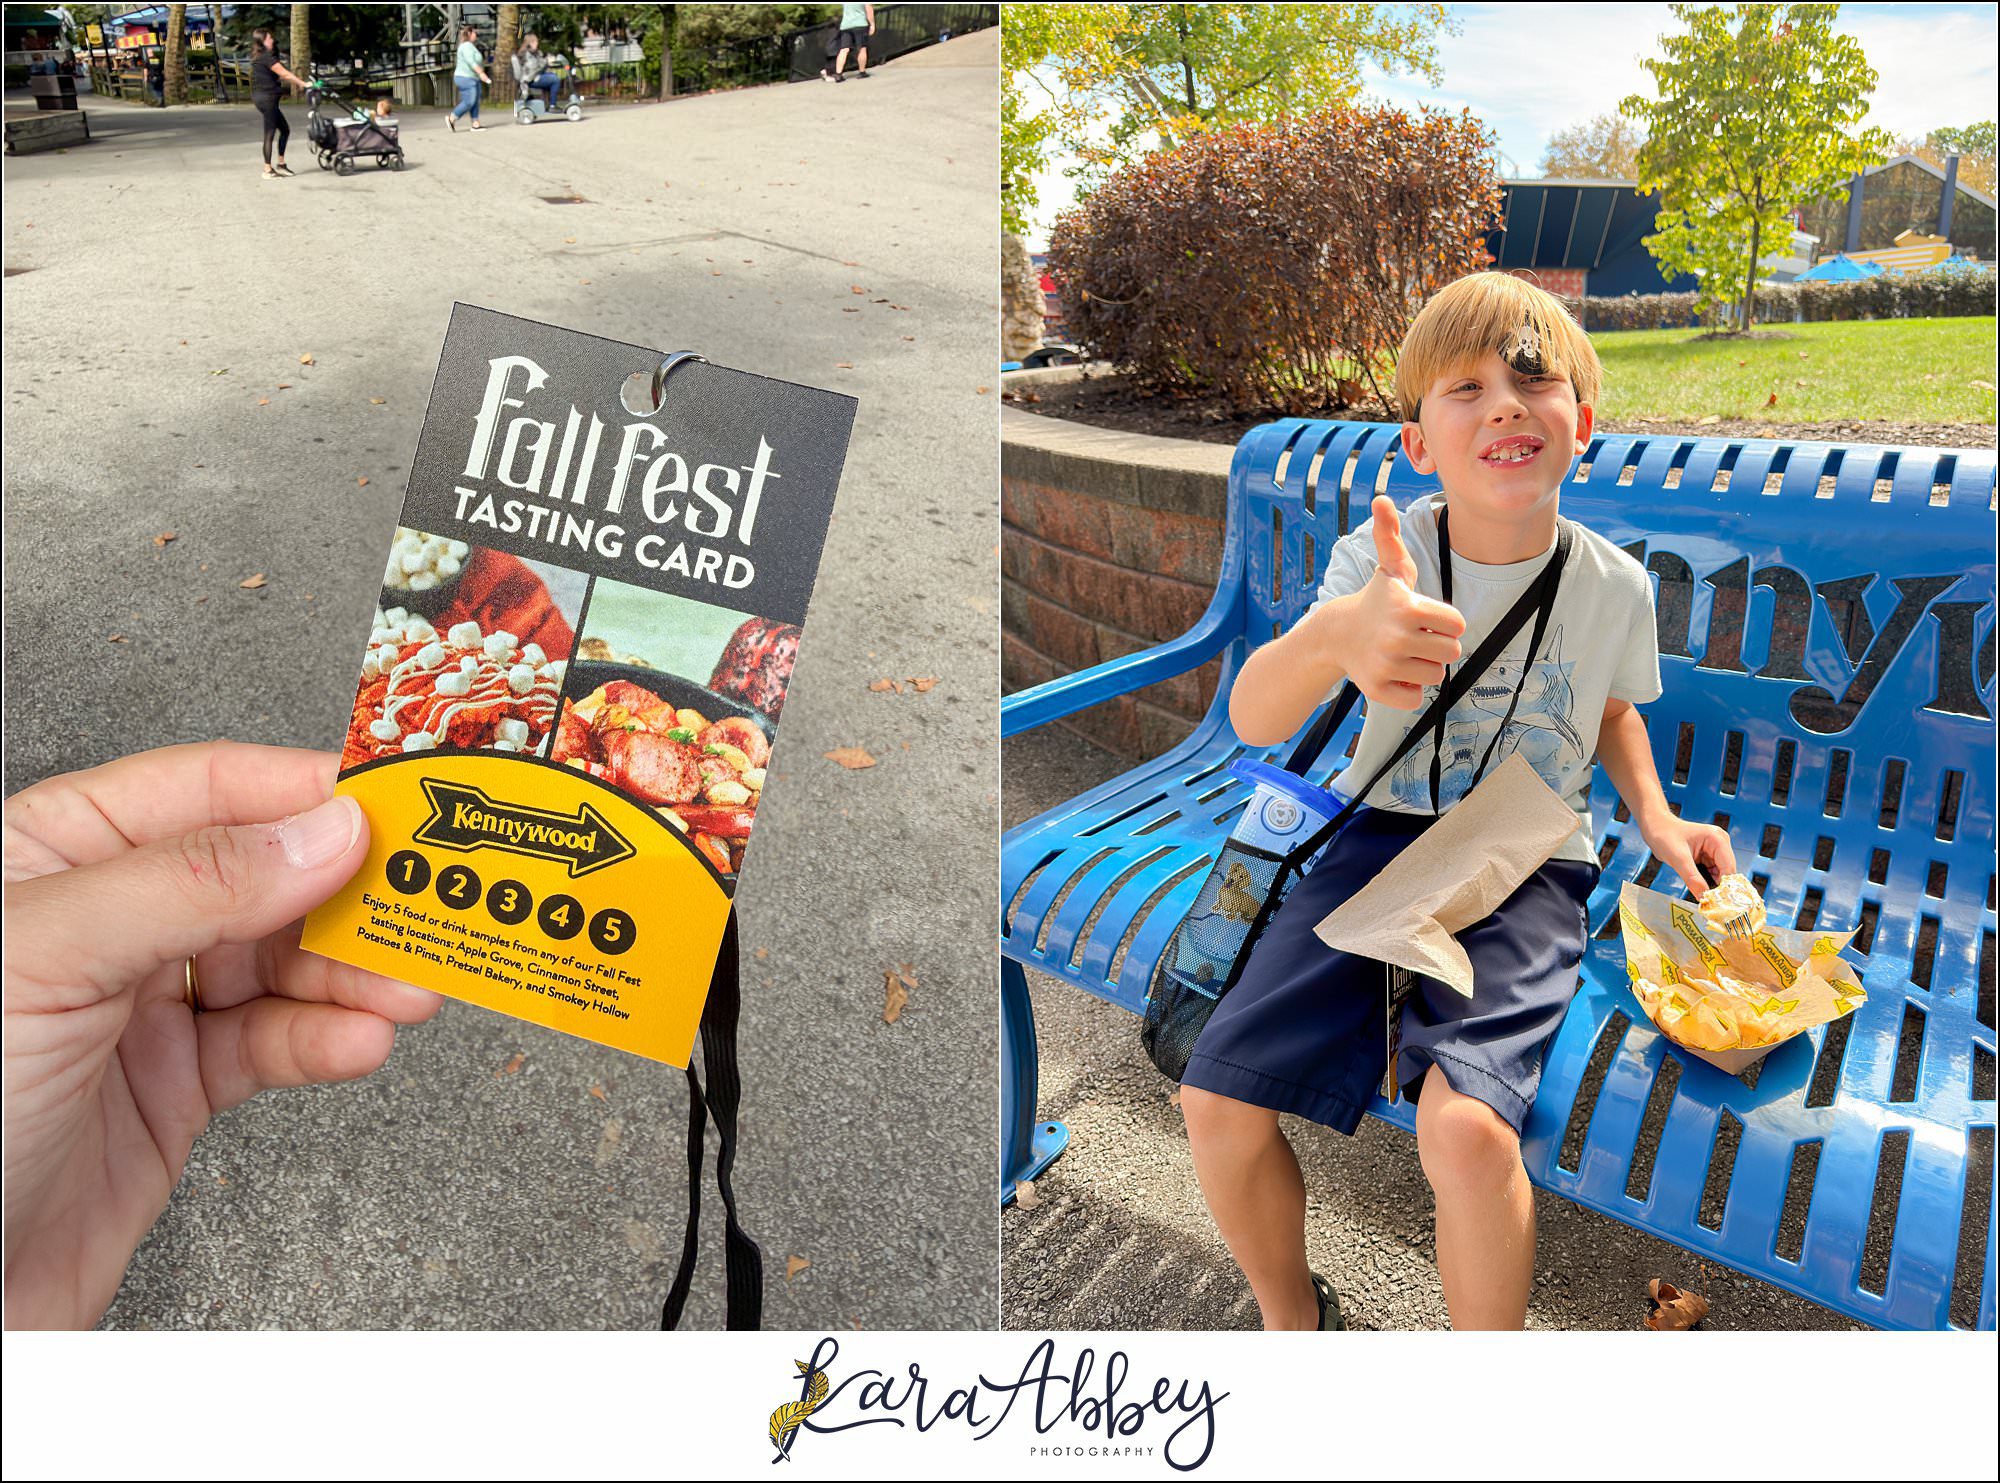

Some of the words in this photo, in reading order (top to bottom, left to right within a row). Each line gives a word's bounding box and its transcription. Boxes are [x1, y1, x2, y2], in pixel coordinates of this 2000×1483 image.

[454, 486, 626, 558] TASTING
[635, 534, 755, 590] CARD
[452, 802, 597, 853] Kennywood
[362, 893, 392, 913] Enjoy
[393, 903, 401, 914] 5
[403, 906, 427, 923] food
[428, 916, 440, 926] or
[441, 919, 467, 935] drink
[469, 930, 510, 948] samples
[512, 940, 538, 957] from
[540, 951, 560, 965] any
[561, 956, 575, 967] of
[575, 961, 594, 972] our
[595, 963, 616, 979] Fall
[617, 971, 642, 987] Fest
[402, 858, 416, 882] 1
[448, 873, 465, 898] 2
[500, 887, 517, 912] 3
[550, 904, 570, 928] 4
[603, 916, 622, 942] 5
[357, 927, 401, 950] Potatoes
[403, 941, 412, 953] &
[414, 945, 443, 965] Pints,
[445, 955, 483, 976] Pretzel
[484, 968, 523, 990] Bakery,
[525, 983, 547, 995] and
[547, 986, 590, 1011] Smokey
[592, 999, 630, 1020] Hollow
[370, 914, 405, 936] tasting
[406, 925, 455, 949] locations:
[455, 941, 488, 959] Apple
[490, 951, 524, 972] Grove,
[527, 962, 582, 988] Cinnamon
[583, 979, 620, 1000] Street,
